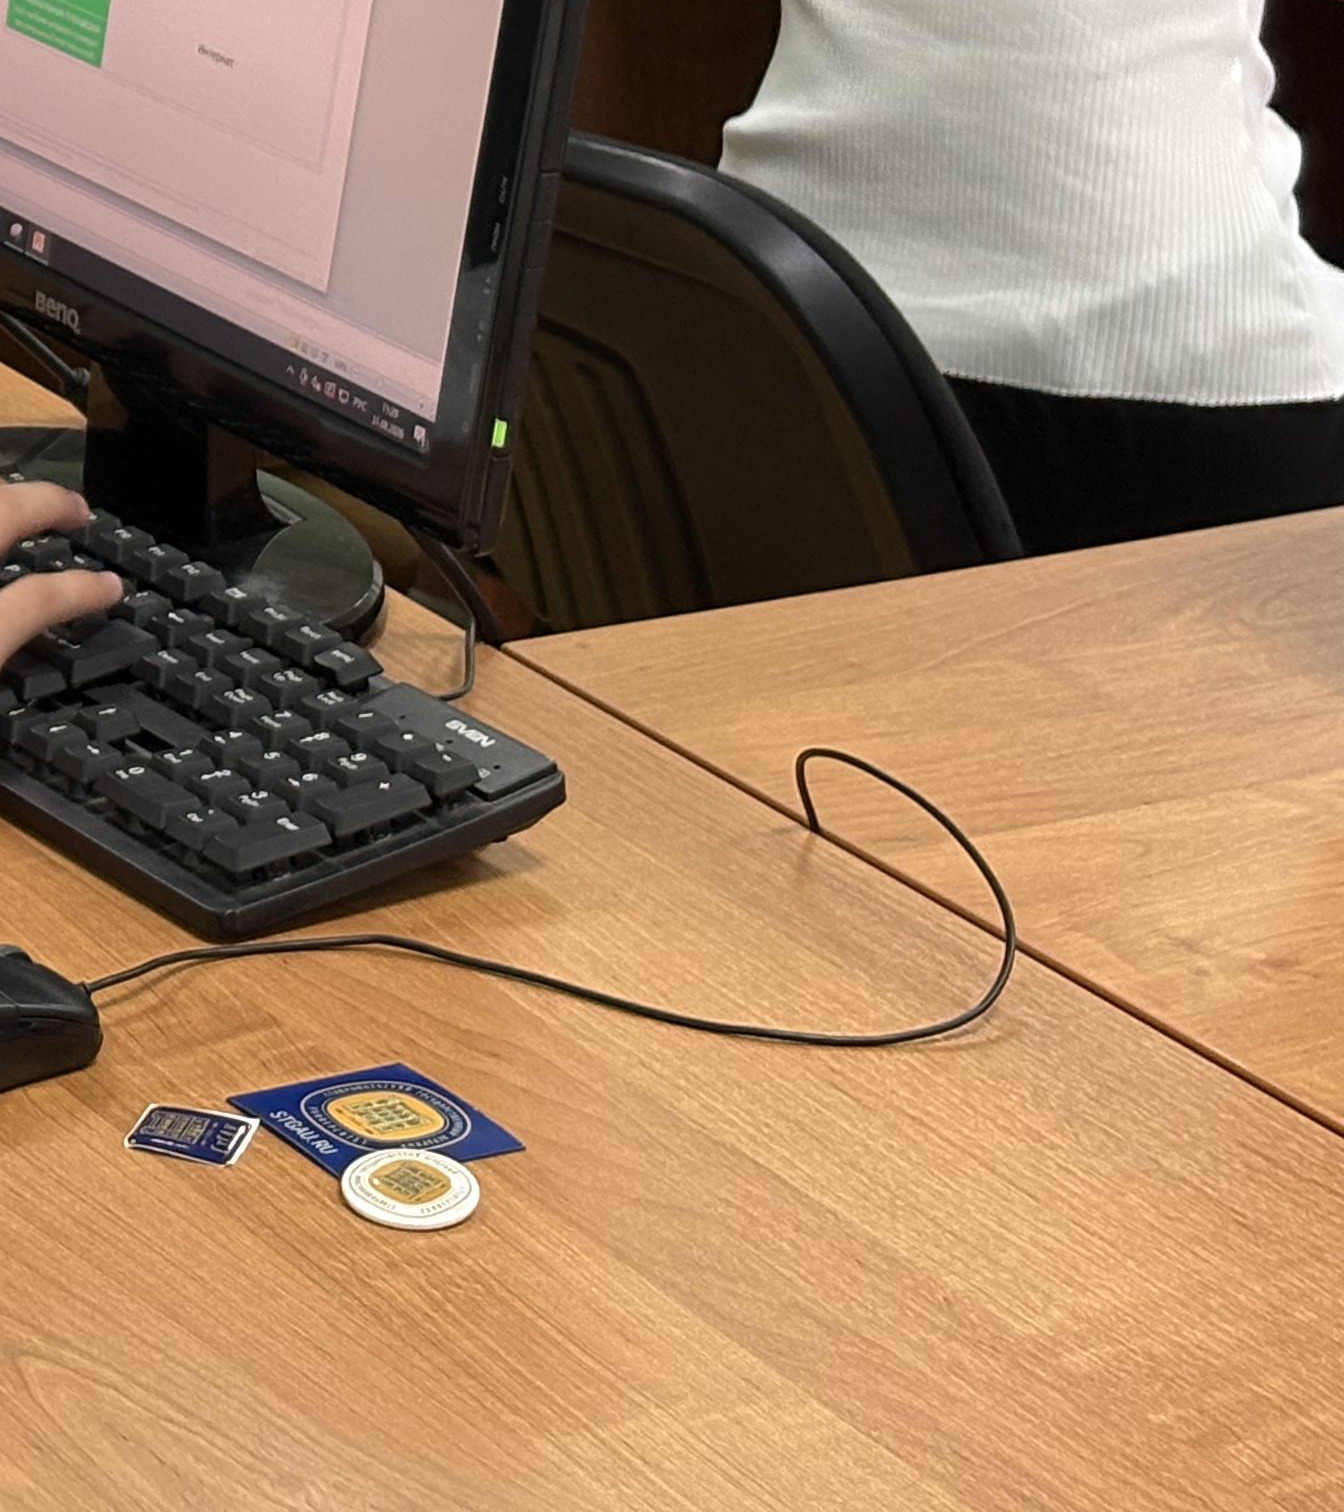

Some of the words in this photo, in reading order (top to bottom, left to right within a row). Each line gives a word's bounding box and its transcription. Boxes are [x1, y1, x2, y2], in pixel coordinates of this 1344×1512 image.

[444, 719, 496, 748] SVEN
[350, 752, 368, 762] 9
[301, 772, 319, 782] 6
[269, 1110, 339, 1155] STGAU.RU
